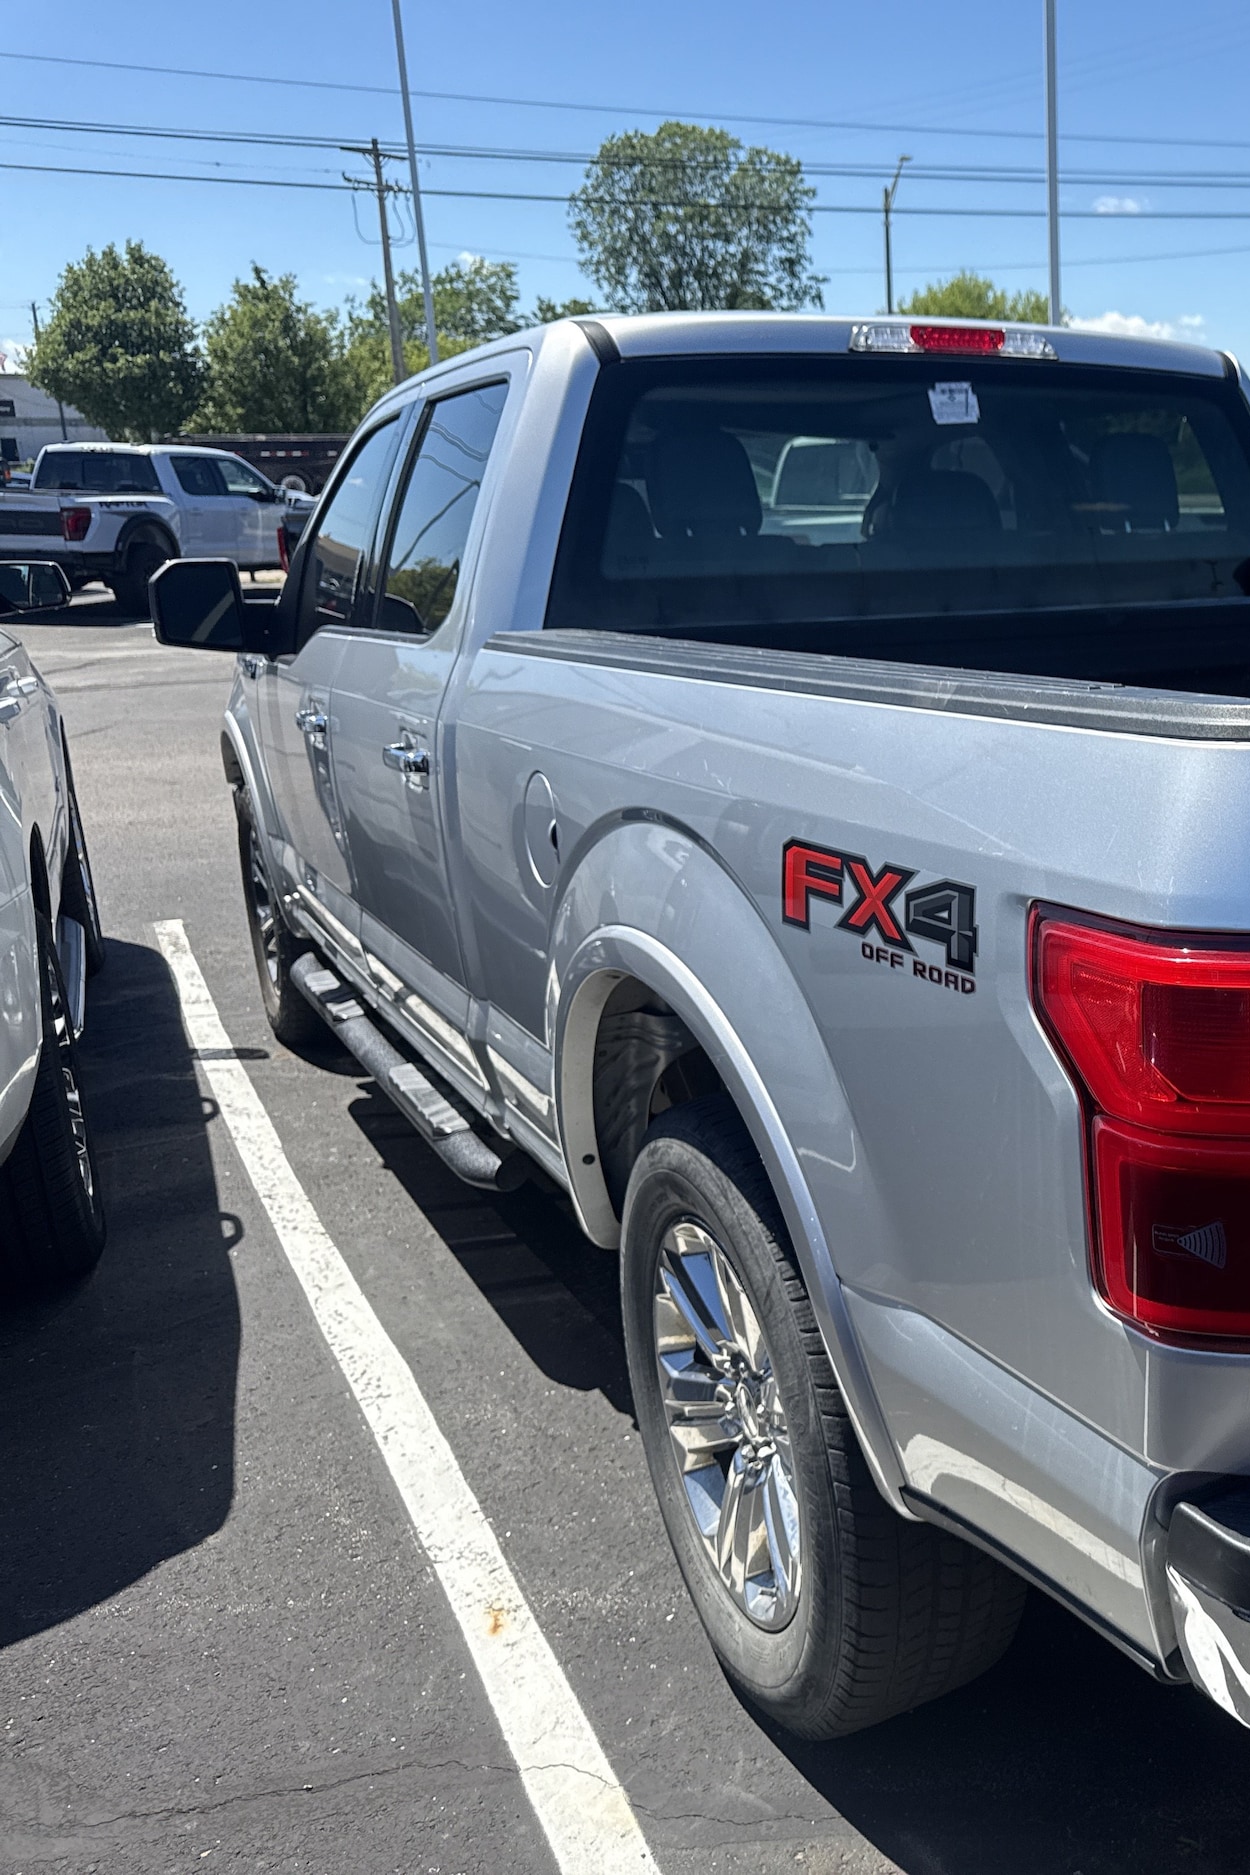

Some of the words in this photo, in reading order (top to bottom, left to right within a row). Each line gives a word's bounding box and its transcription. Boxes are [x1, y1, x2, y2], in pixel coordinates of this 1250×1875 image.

[781, 835, 979, 977] FX4
[860, 941, 905, 969] OFF
[911, 957, 977, 996] ROAD
